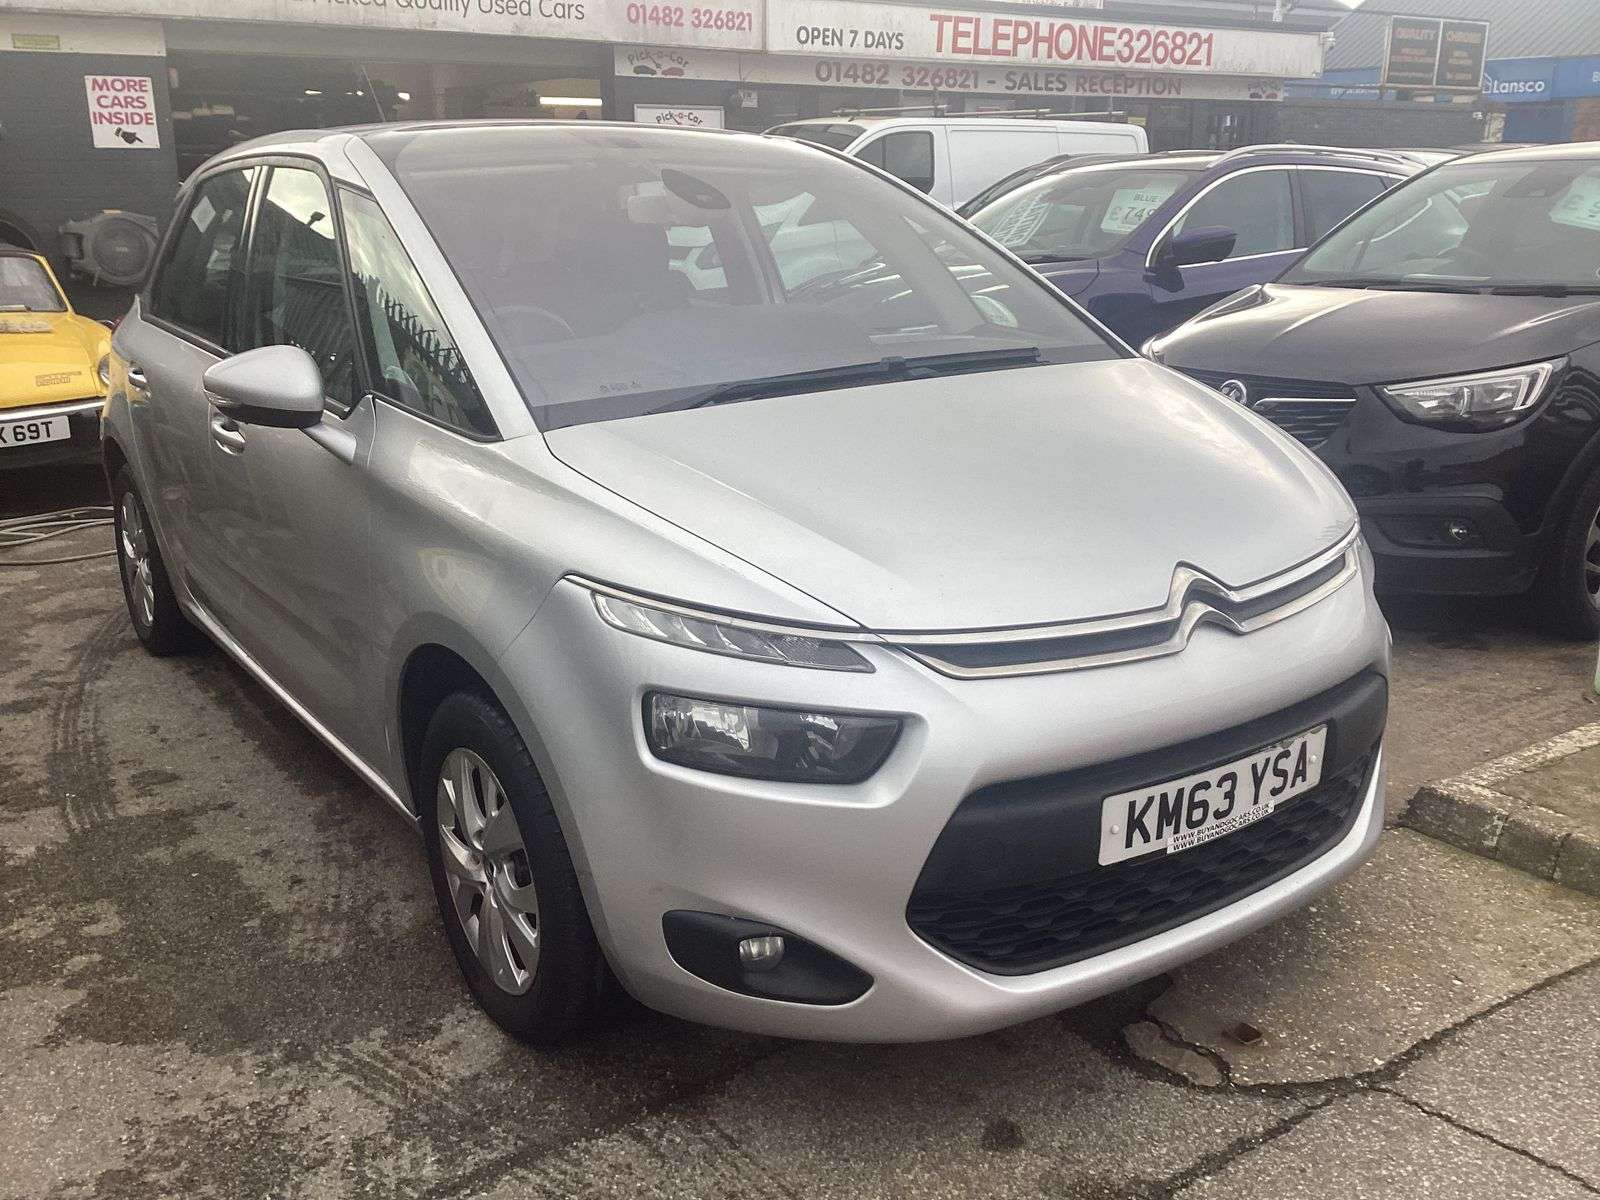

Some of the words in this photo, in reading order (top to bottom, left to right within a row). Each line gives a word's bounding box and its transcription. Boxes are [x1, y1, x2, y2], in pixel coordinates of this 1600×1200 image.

[478, 0, 532, 16] Used
[538, 0, 585, 20] Cars
[627, 3, 684, 27] 01482
[691, 8, 752, 32] 326821
[796, 26, 843, 46] OPEN
[850, 30, 859, 47] 7
[864, 31, 904, 50] DAYS
[91, 78, 148, 92] MORE
[815, 60, 890, 84] 01482
[902, 65, 979, 89] 326821
[1005, 71, 1067, 92] SALES
[1075, 74, 1182, 95] RECEPTION
[1493, 80, 1545, 94] Lansco
[96, 95, 147, 109] CARS
[93, 112, 155, 125] INSIDE
[1134, 192, 1160, 203] BLUE
[13, 421, 52, 442] 69T
[1125, 771, 1238, 849] KM63
[1251, 741, 1308, 805] YSA
